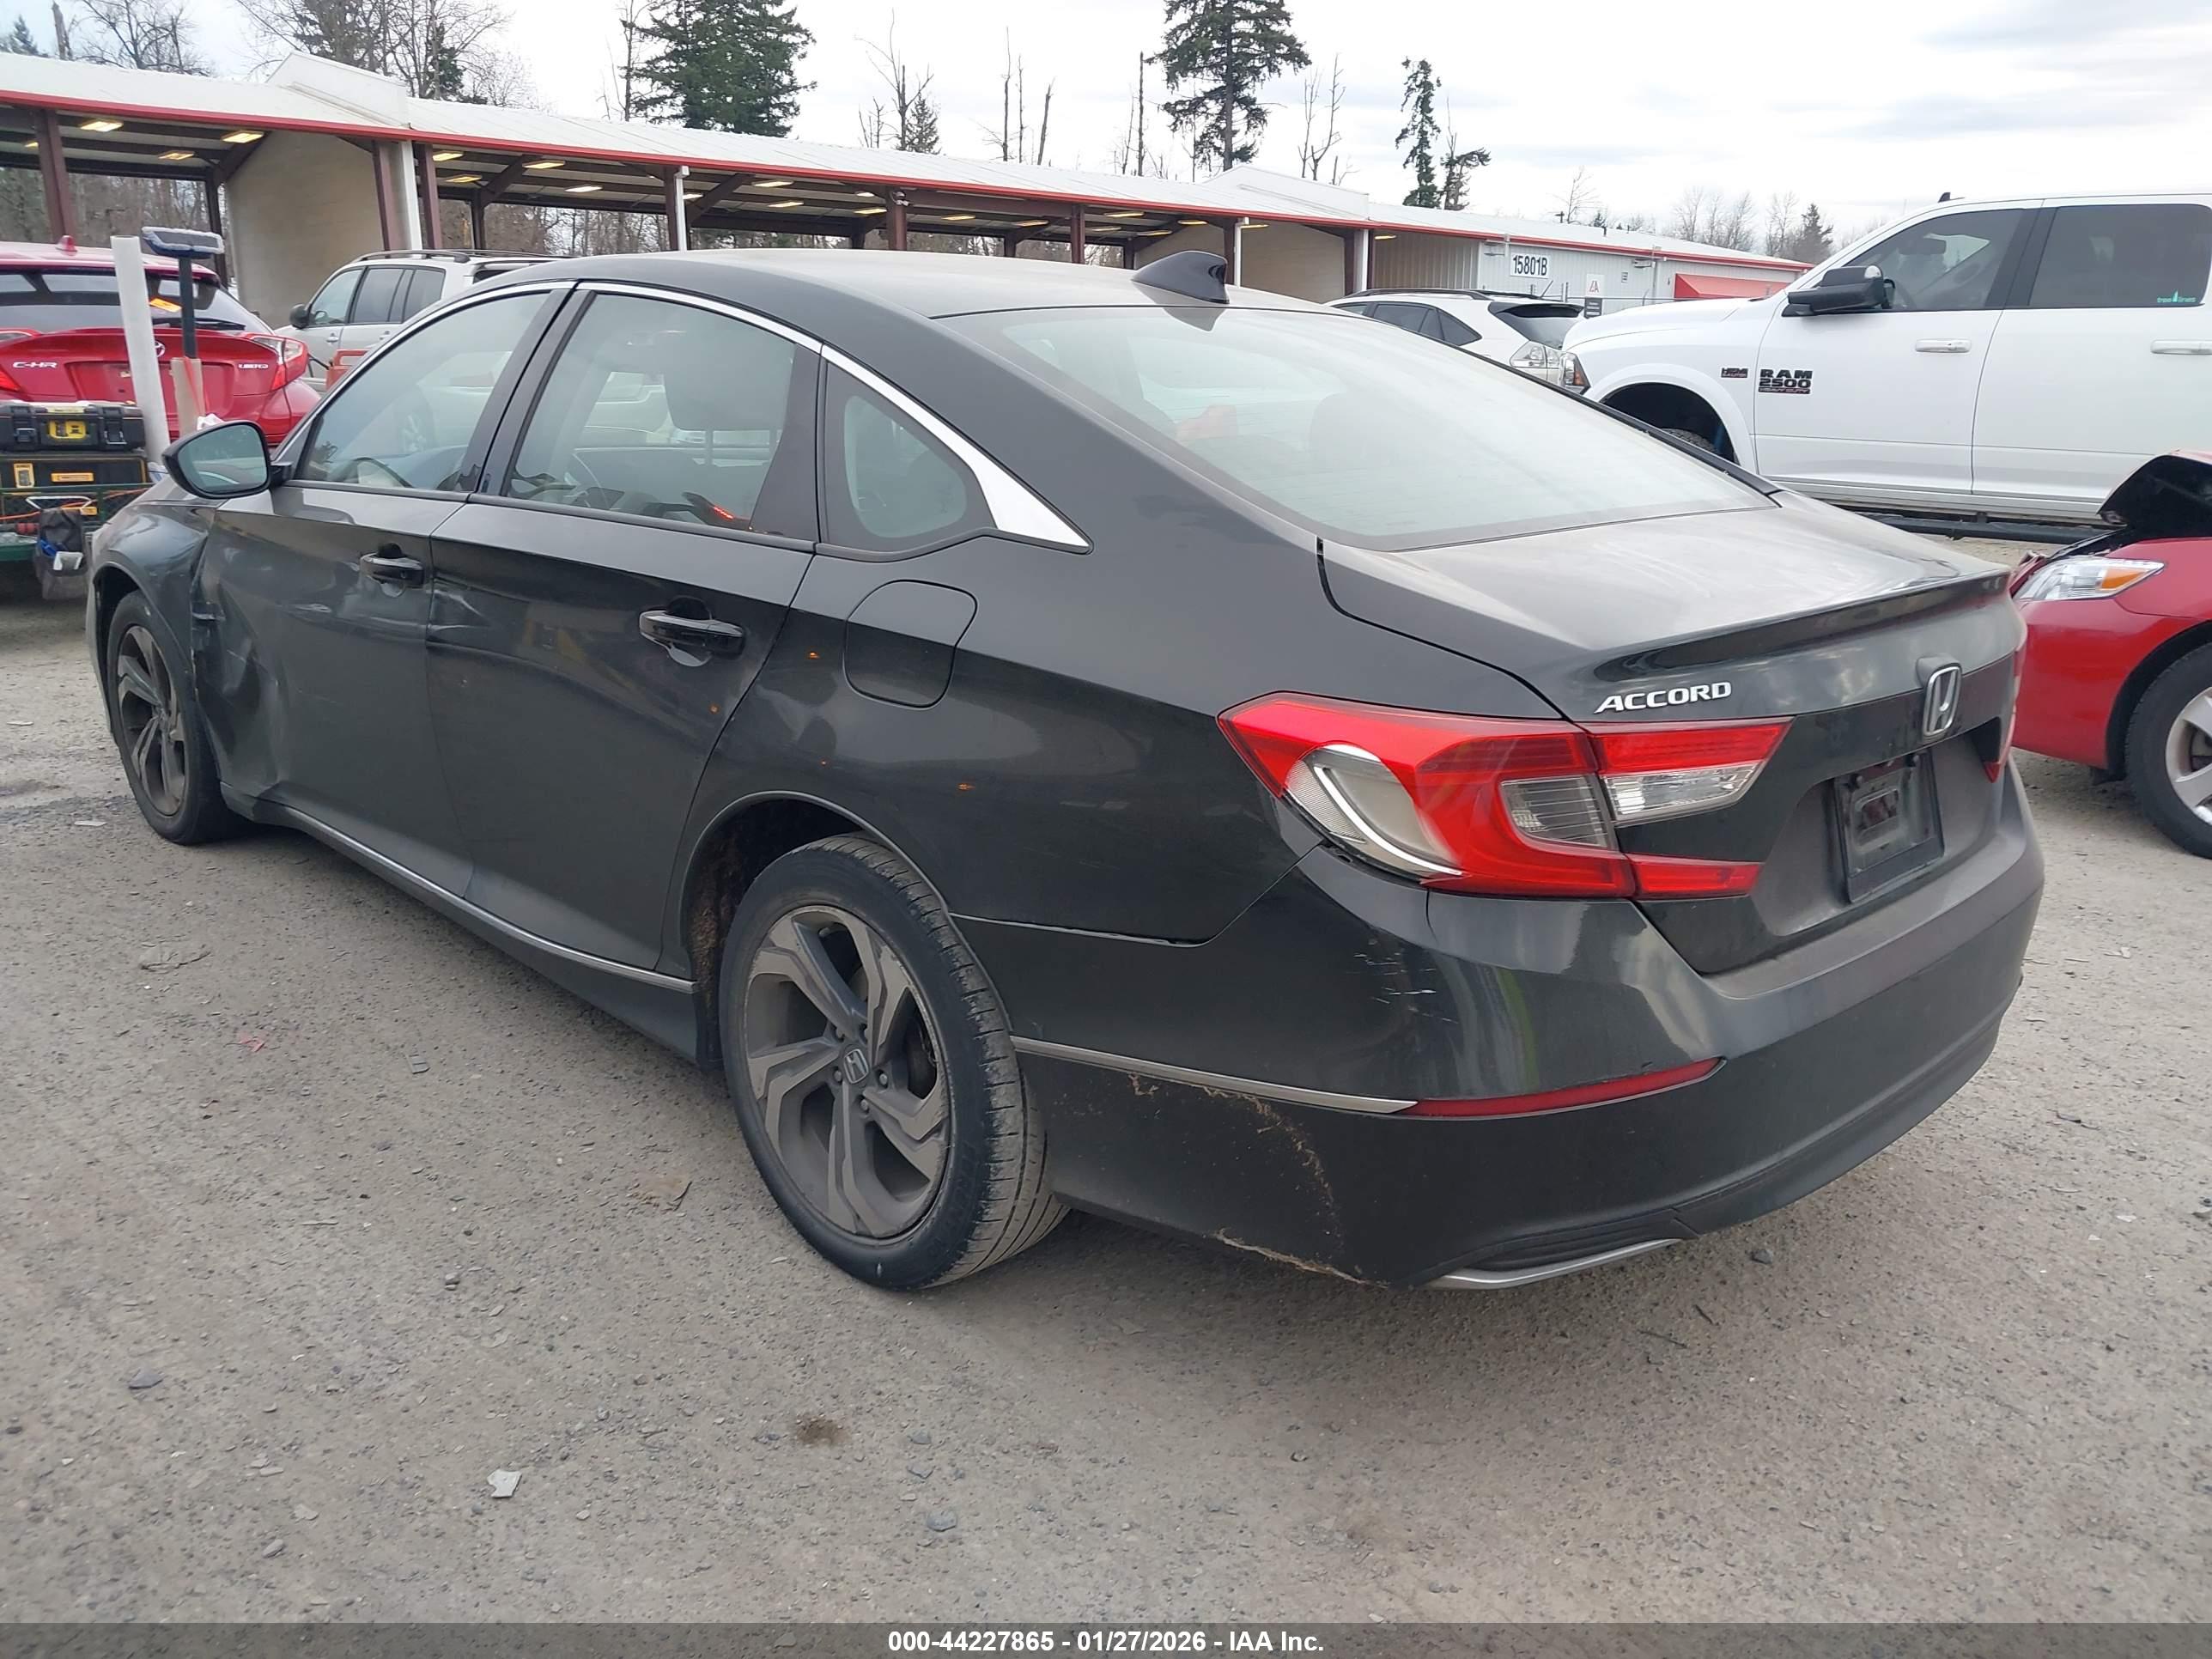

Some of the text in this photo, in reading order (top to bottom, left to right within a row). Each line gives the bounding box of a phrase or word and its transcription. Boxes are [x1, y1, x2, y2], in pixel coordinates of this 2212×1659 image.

[1513, 255, 1547, 276] 15801B
[1759, 369, 1813, 379] RAM
[1759, 378, 1811, 388] 2500
[1594, 682, 1732, 714] ACCORD
